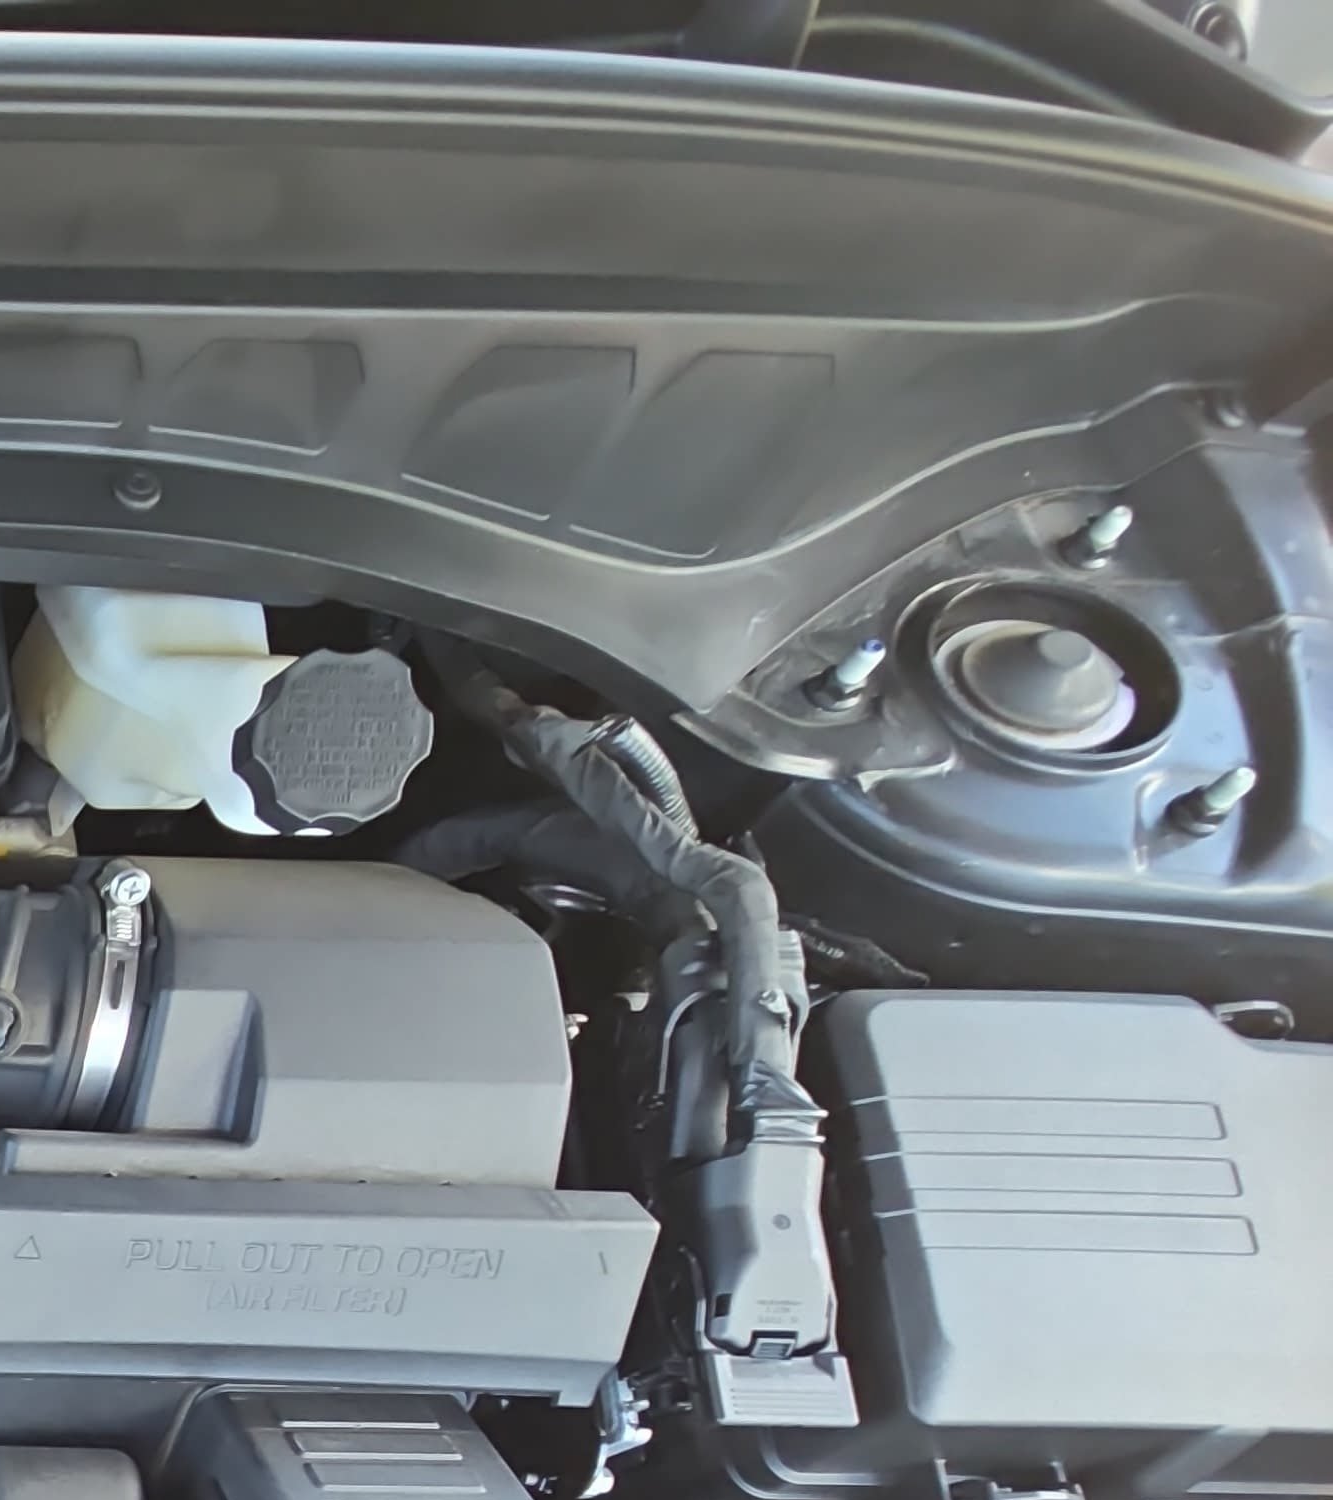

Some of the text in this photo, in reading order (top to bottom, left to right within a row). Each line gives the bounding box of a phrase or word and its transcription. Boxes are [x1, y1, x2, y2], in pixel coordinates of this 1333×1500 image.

[125, 1239, 504, 1280] PULL OUT TO OPEN
